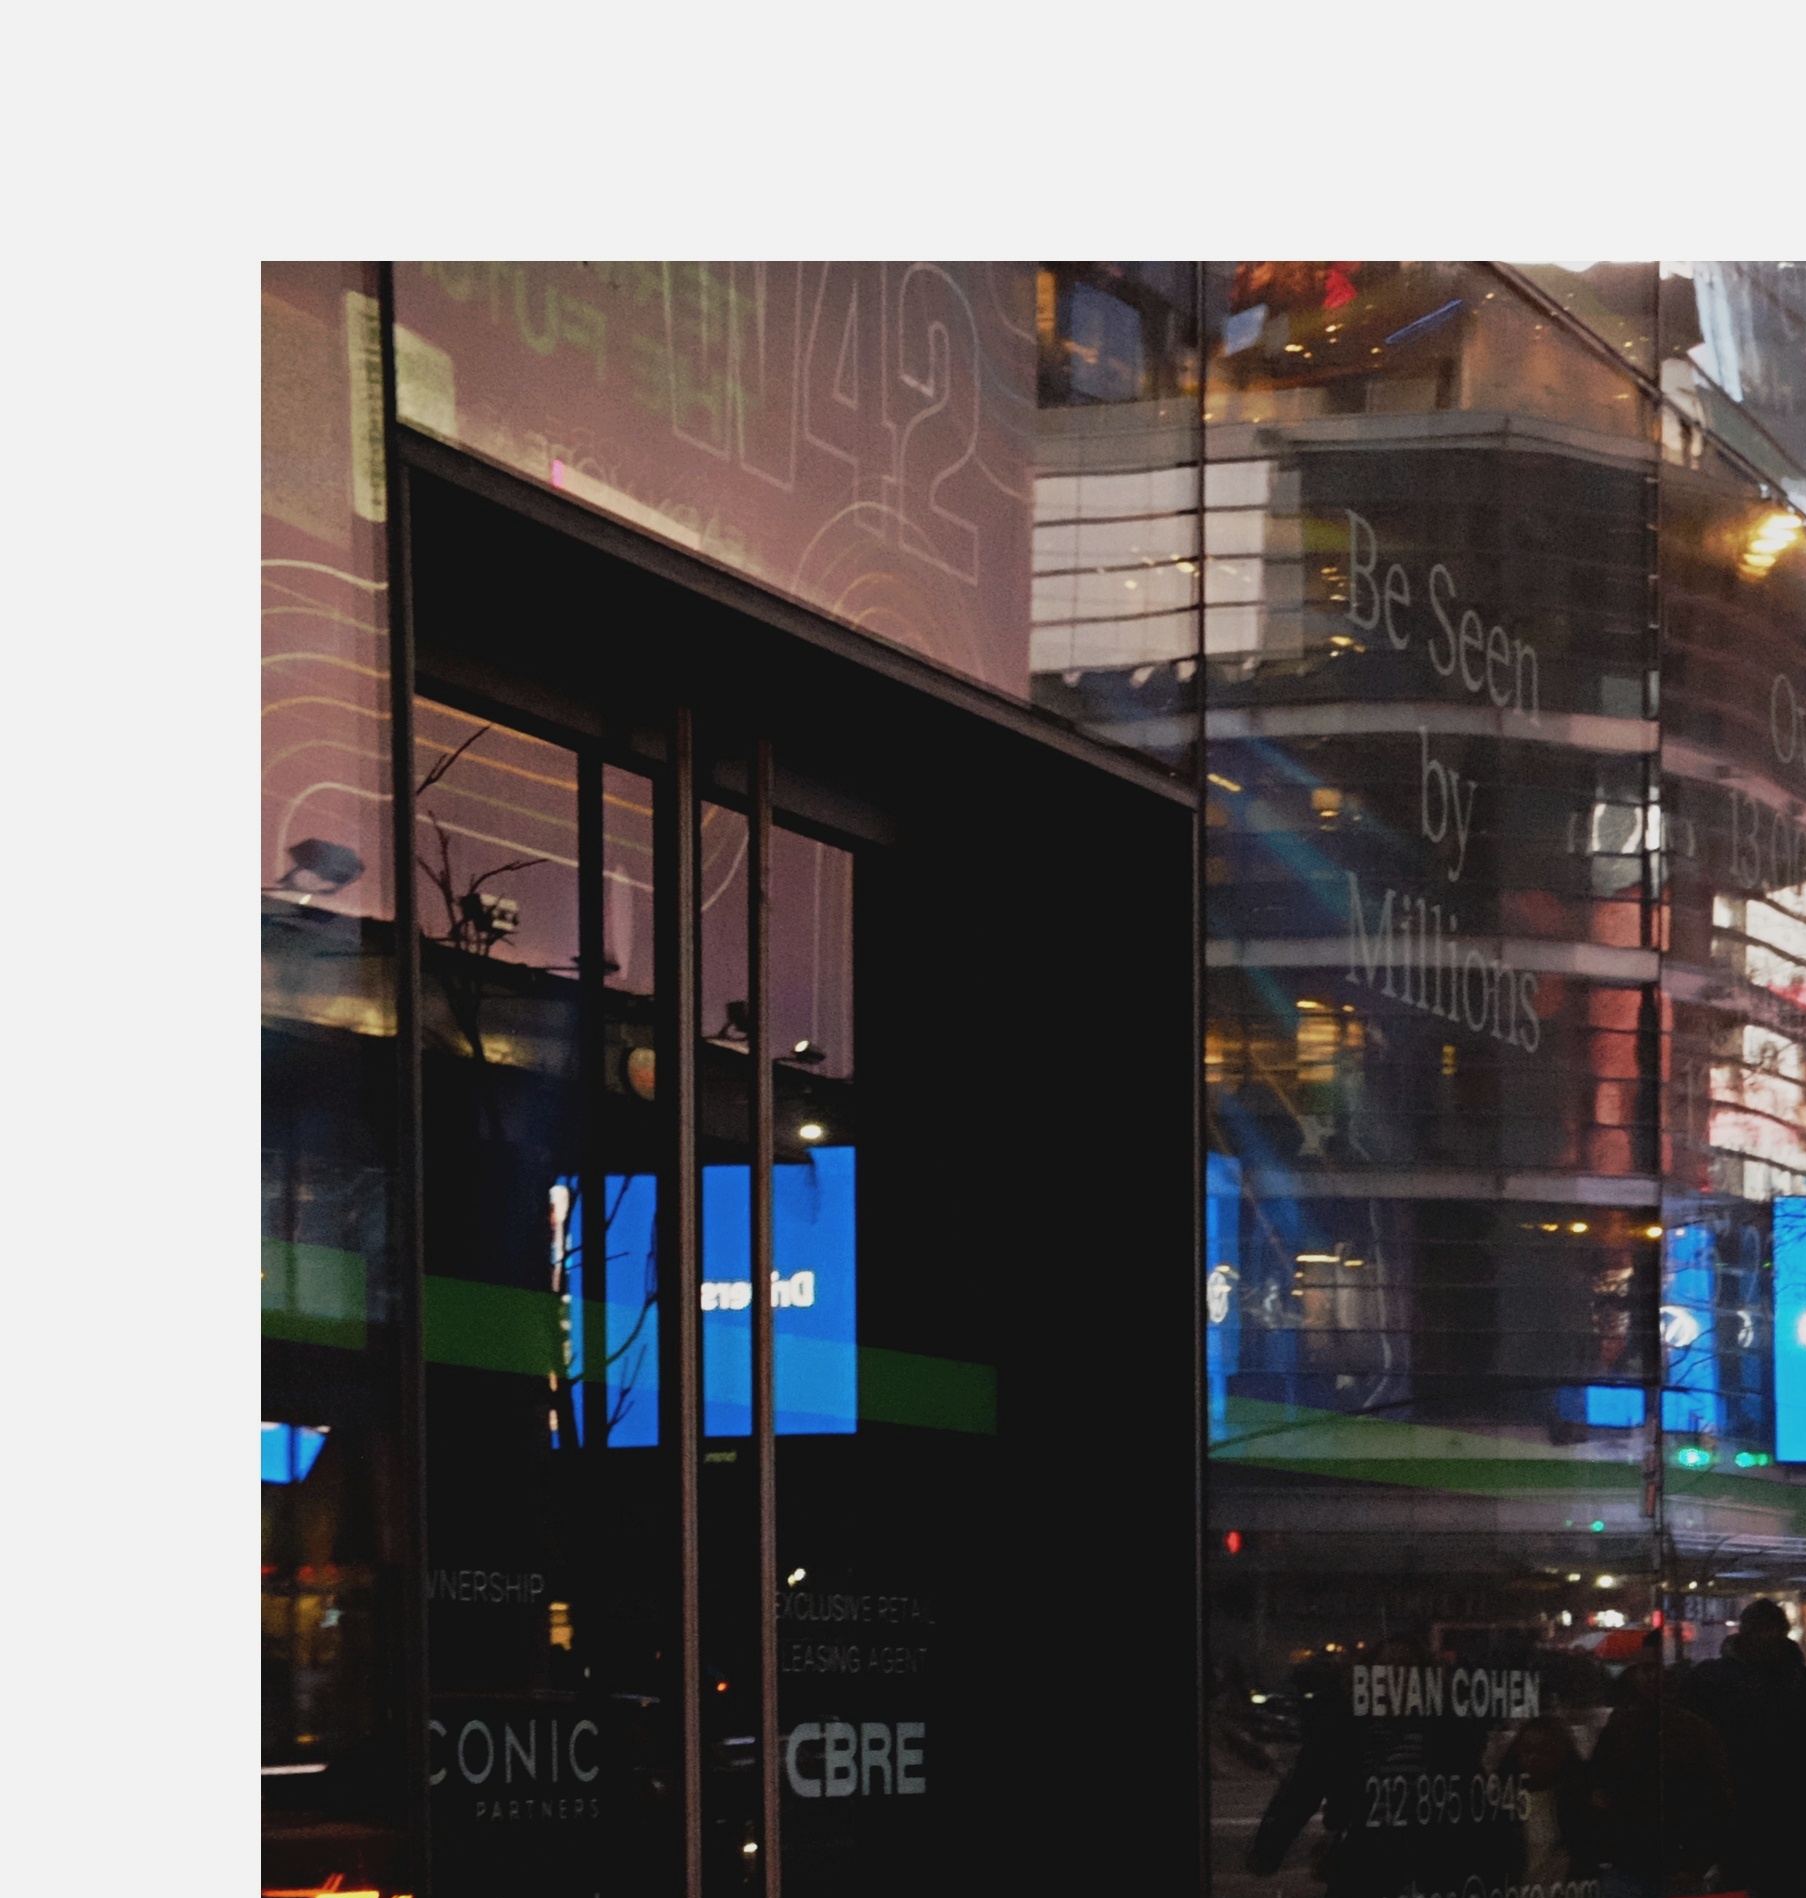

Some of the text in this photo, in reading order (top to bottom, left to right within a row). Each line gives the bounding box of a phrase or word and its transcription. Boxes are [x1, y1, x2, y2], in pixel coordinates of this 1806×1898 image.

[1346, 509, 1541, 727] Be Seen
[1419, 726, 1478, 882] by
[1346, 871, 1541, 1054] Millions
[1352, 1664, 1542, 1719] BEVAN COHEN
[429, 1718, 600, 1785] CONIC
[784, 1721, 927, 1798] CBRE
[474, 1798, 600, 1822] PARTNERS
[1364, 1772, 1534, 1829] 212 895 0945
